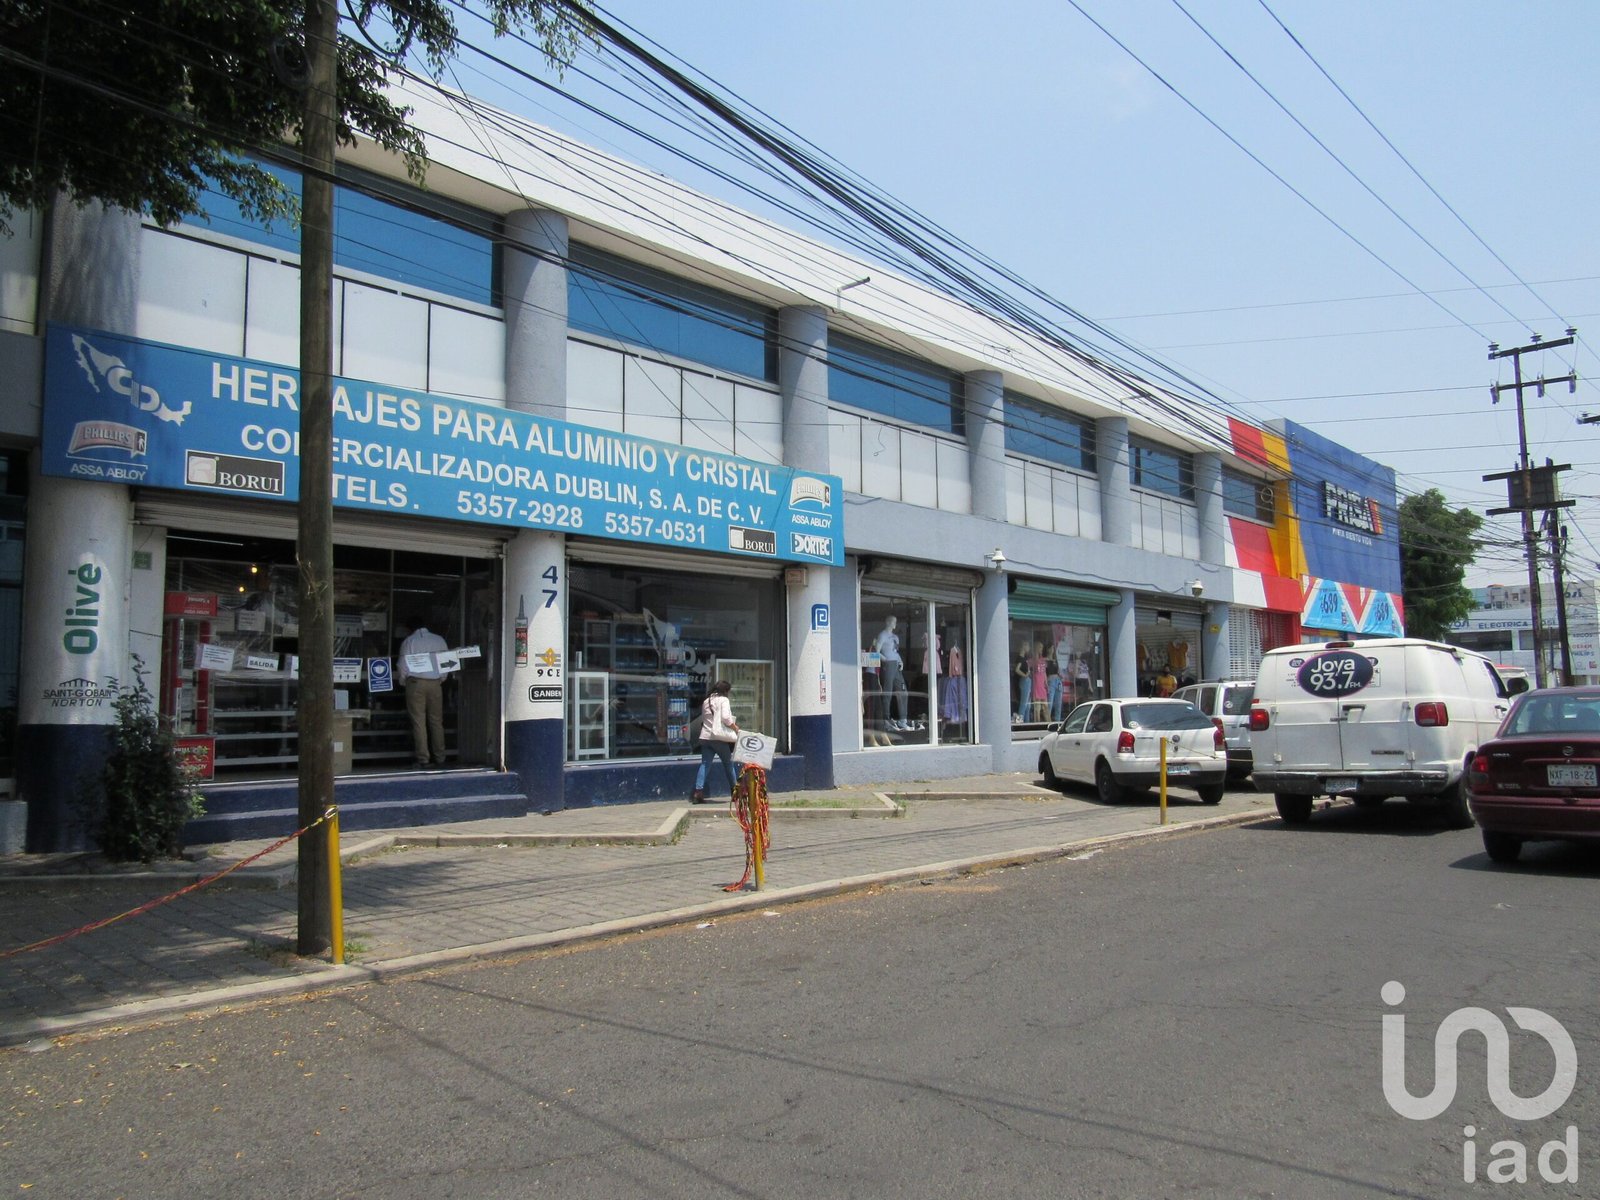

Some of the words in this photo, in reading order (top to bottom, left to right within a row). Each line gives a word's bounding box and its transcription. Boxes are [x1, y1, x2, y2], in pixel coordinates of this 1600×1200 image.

[84, 427, 131, 444] PHILLIPS
[212, 362, 420, 431] HERAJES
[433, 403, 519, 449] PARA
[525, 423, 657, 473] ALUMINIO
[664, 449, 679, 477] Y
[686, 454, 777, 495] CRISTAL
[70, 463, 104, 477] ASSA
[106, 467, 146, 480] ABLOY
[241, 424, 549, 492] CORCIALIZADORA
[555, 472, 643, 510] DUBLIN,
[650, 488, 667, 510] S.
[673, 493, 691, 513] A.
[698, 496, 722, 518] DE
[727, 502, 745, 522] C.
[749, 505, 764, 525] V.
[218, 472, 280, 492] BORUI
[457, 491, 583, 528] 5357-2928
[605, 511, 705, 544] 5357-0531
[792, 513, 809, 525] ASSA
[810, 517, 831, 528] ABLOY
[745, 539, 775, 553] BORUI
[1478, 621, 1528, 629] ELECTRICA
[249, 660, 274, 668] SALIDA
[1311, 658, 1355, 676] Joya
[1310, 671, 1354, 691] 93.7
[43, 688, 112, 698] SAINT-GOBAIN
[52, 698, 102, 707] NORTON
